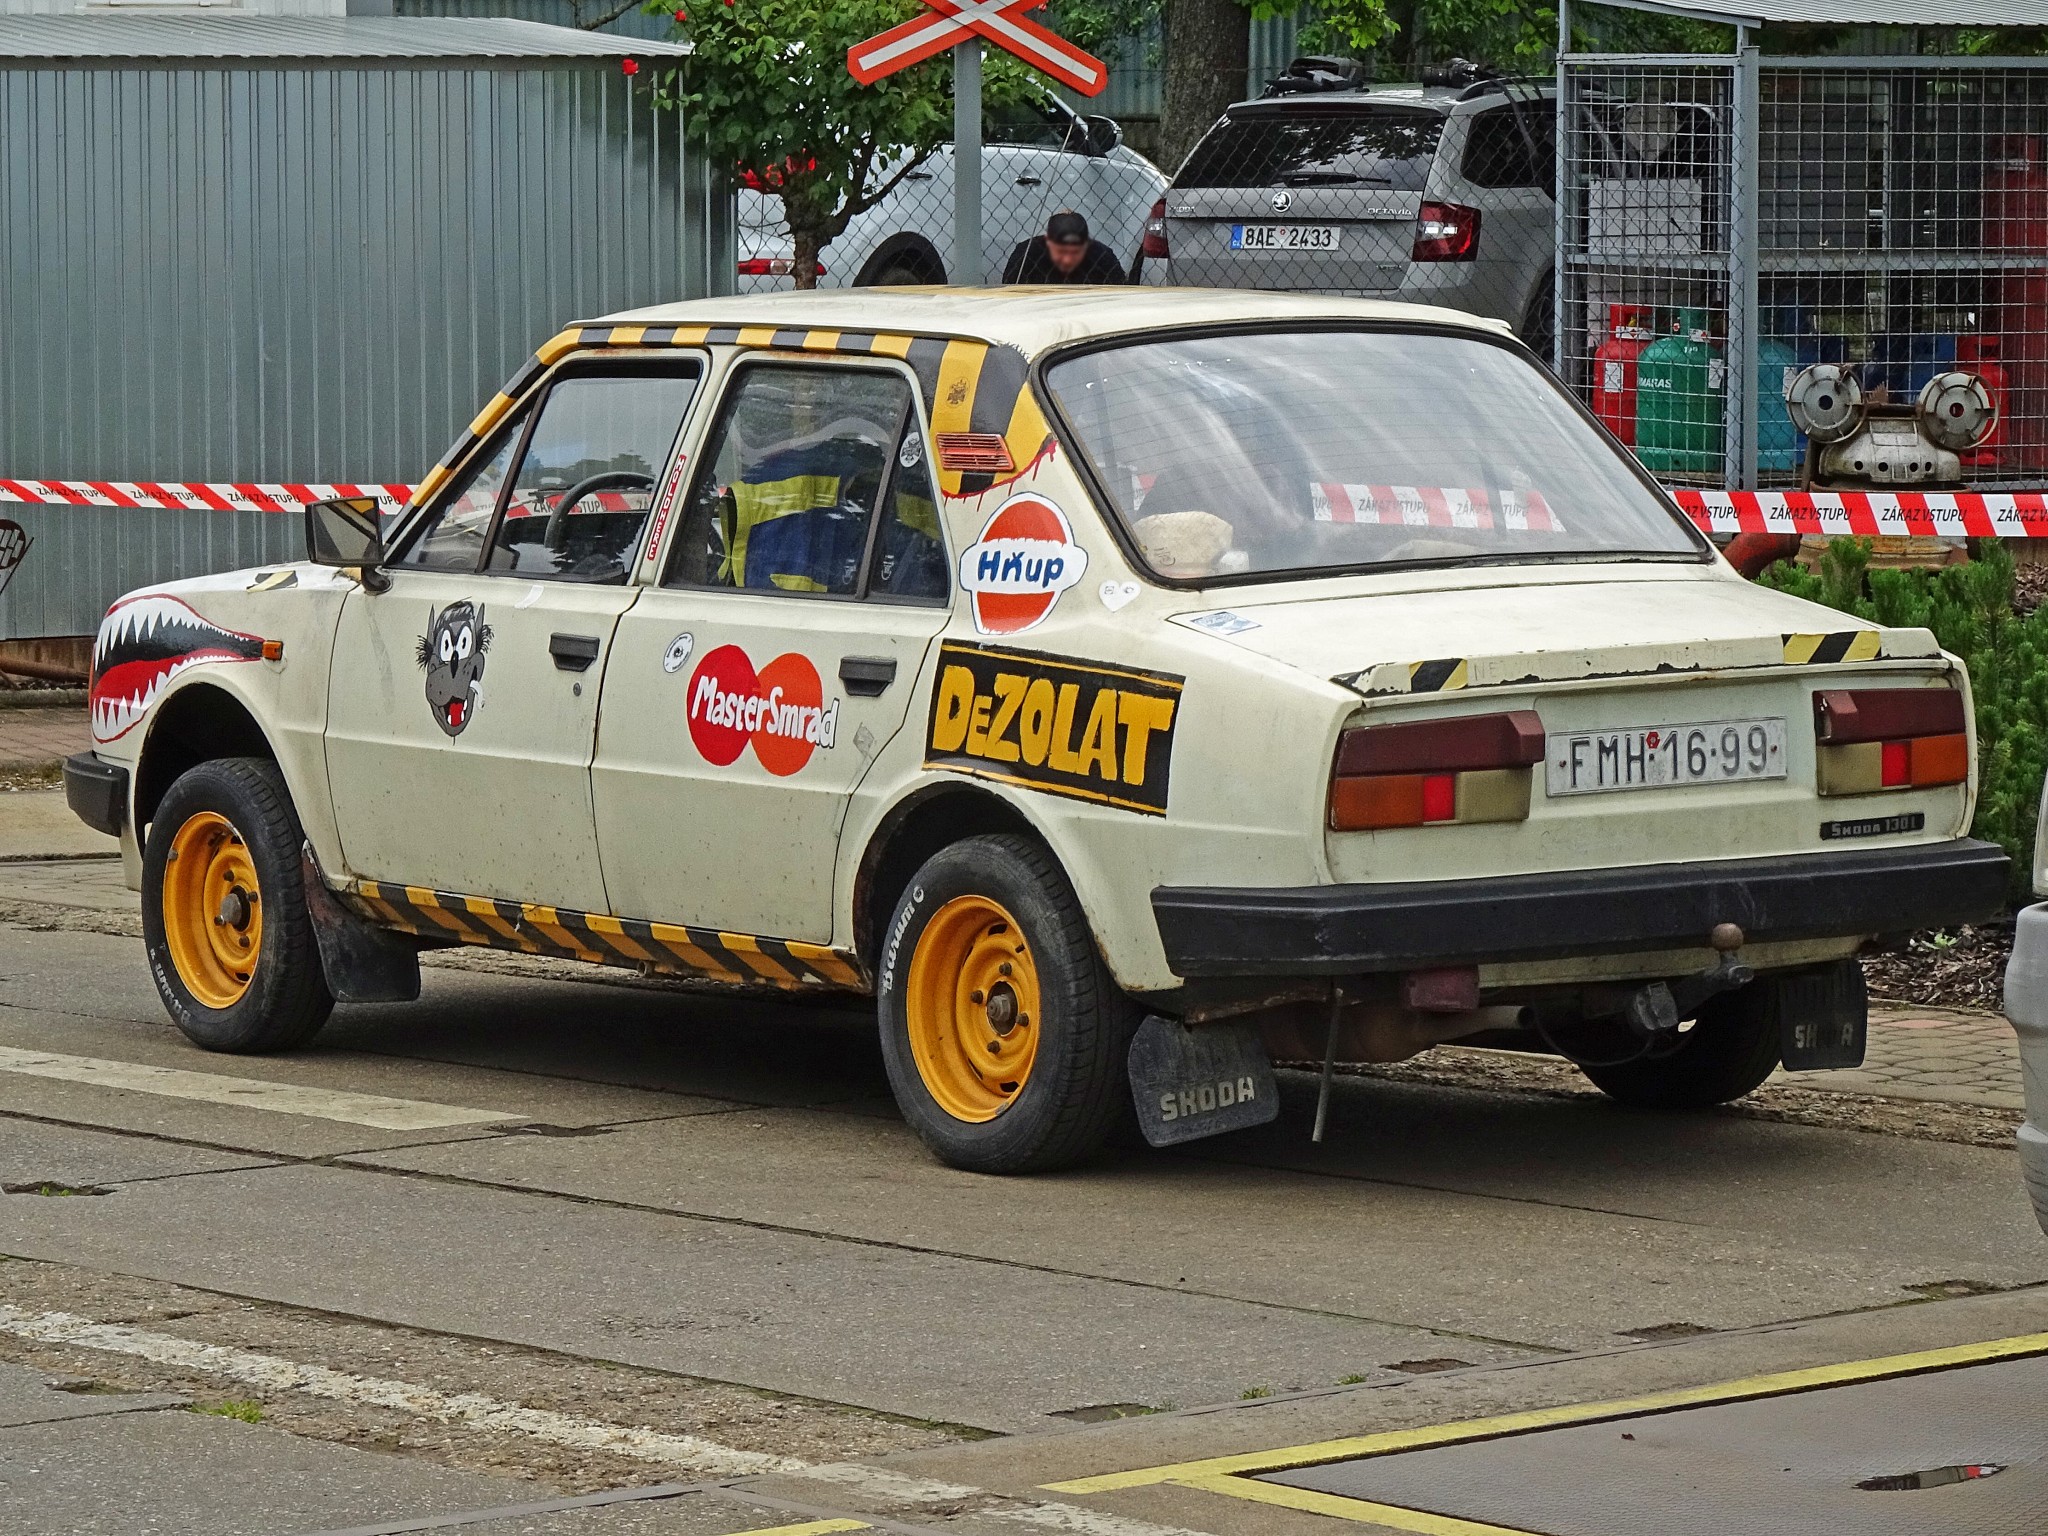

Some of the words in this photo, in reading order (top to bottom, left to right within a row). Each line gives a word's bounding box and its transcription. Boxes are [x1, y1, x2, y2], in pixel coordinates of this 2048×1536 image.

[1367, 207, 1412, 216] OCTAVIA
[1245, 227, 1275, 247] 8AE
[1288, 228, 1332, 248] 2433
[36, 486, 68, 497] ZÁKAZ
[69, 488, 107, 498] VSTUPU
[131, 488, 163, 500] ZÁKAZ
[165, 491, 203, 501] VSTUPU
[227, 491, 260, 503] ZÁKAZ
[262, 494, 302, 504] VSTUPU
[1700, 505, 1742, 518] VSTUPU
[1769, 504, 1808, 520] ZÁKAZ
[1810, 507, 1852, 520] VSTUPU
[1881, 506, 1919, 521] ZÁKAZ
[1922, 508, 1967, 521] VSTUPU
[1997, 506, 2038, 521] ZÁKAZ
[691, 675, 840, 749] MasterSmrad
[1159, 1076, 1255, 1122] SKODA
